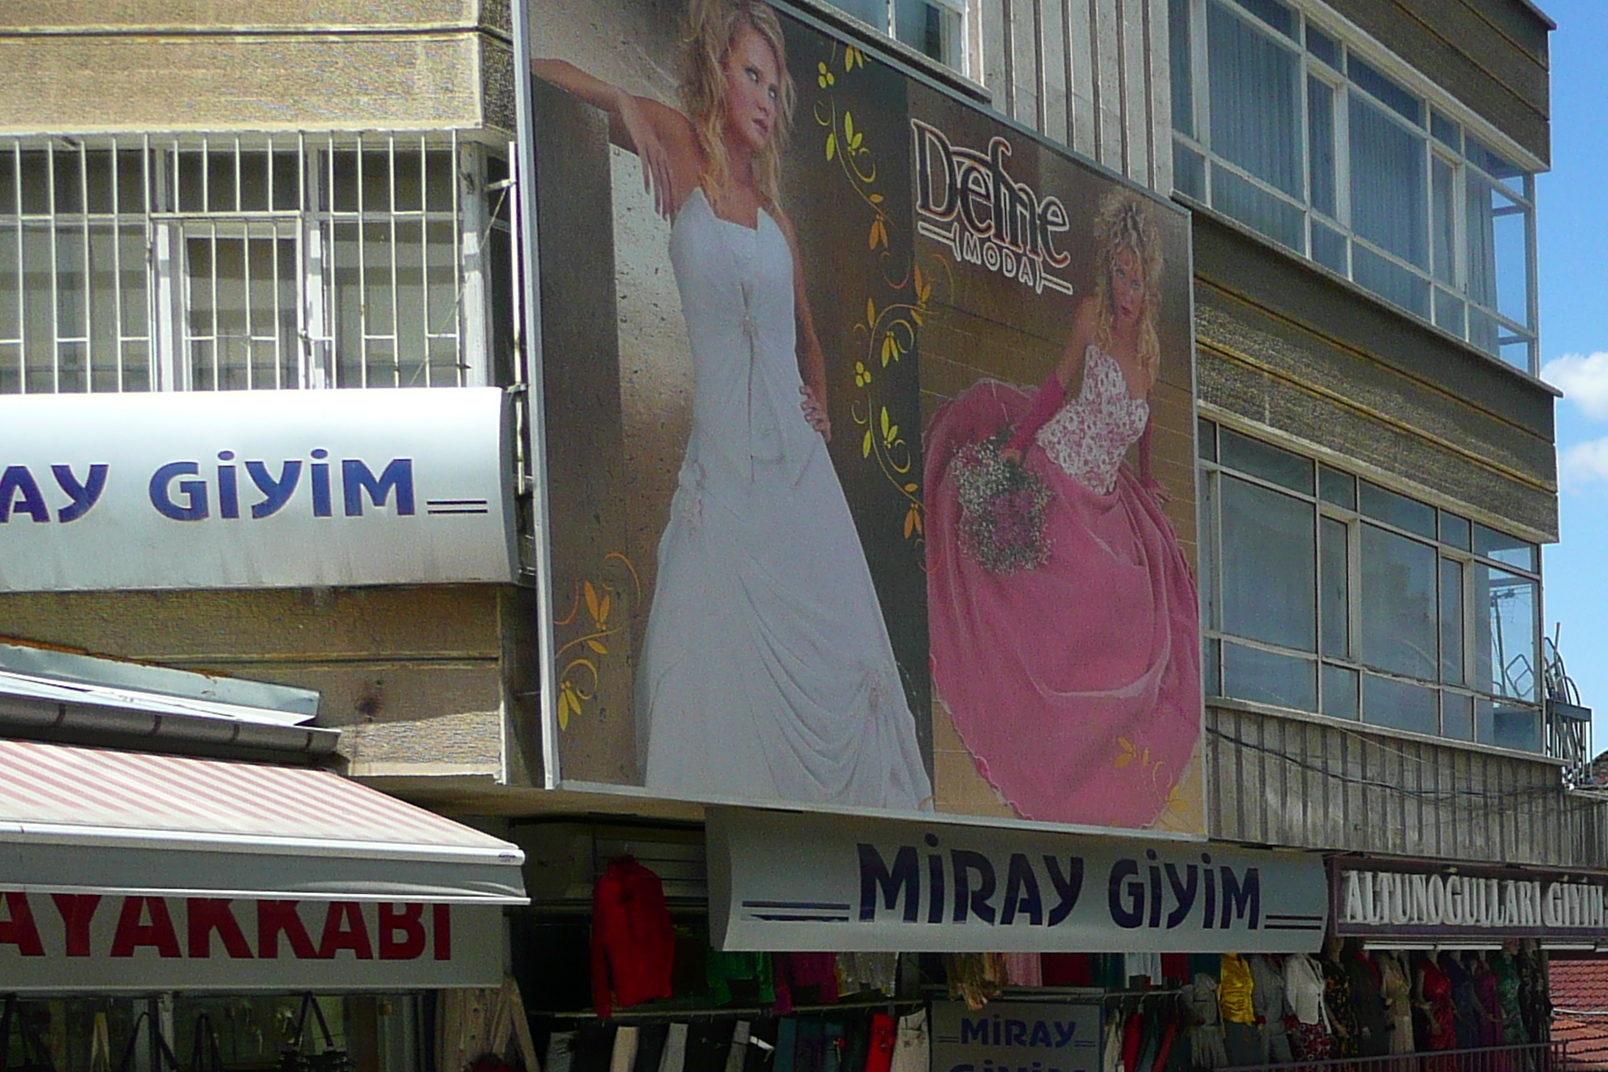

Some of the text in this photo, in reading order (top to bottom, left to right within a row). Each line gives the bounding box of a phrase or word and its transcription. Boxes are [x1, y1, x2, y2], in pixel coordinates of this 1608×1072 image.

[911, 117, 1070, 268] Defne
[148, 448, 416, 522] GİYİM
[856, 832, 1260, 930] MİRAY GİYİM
[961, 1014, 1076, 1048] MİRAY
